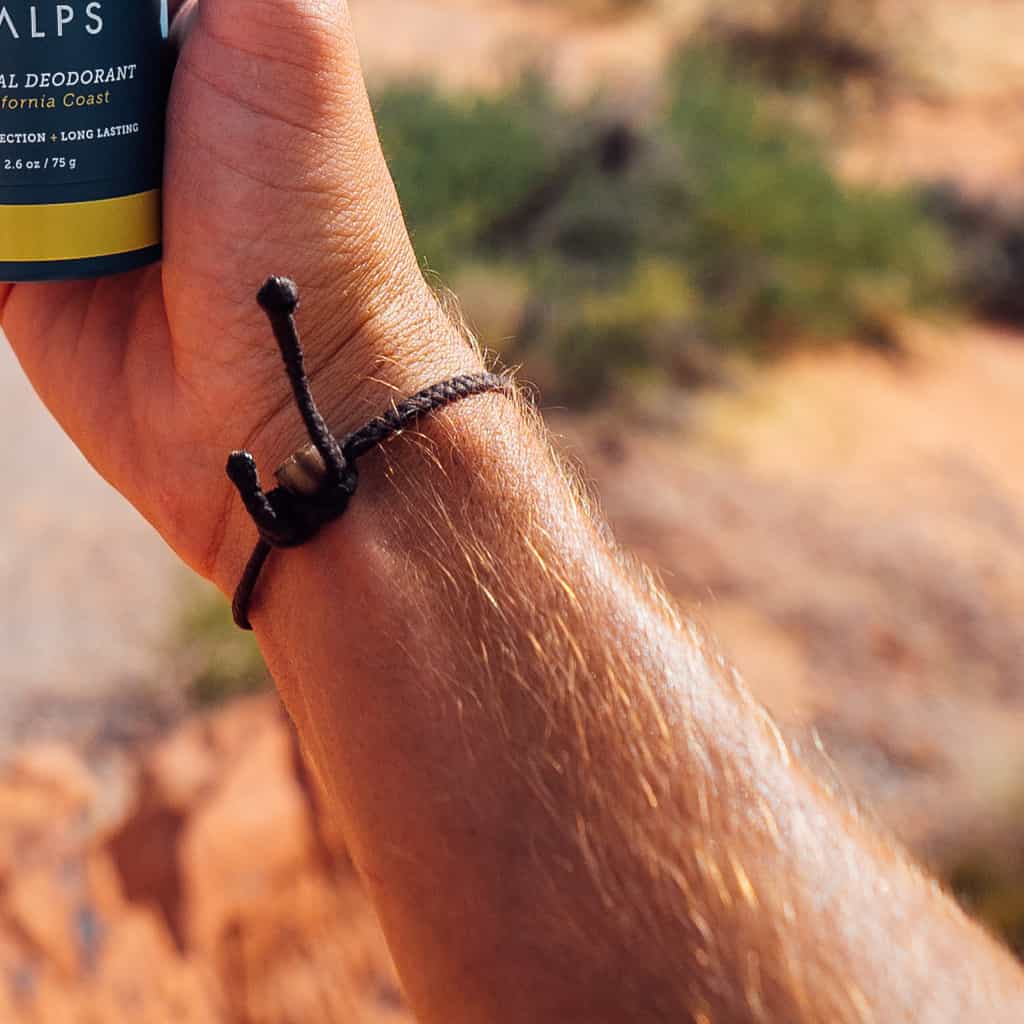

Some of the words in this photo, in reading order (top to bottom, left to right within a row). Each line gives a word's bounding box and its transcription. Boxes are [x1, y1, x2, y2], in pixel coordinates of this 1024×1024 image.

[24, 64, 137, 88] DEODORANT
[63, 90, 110, 107] Coast
[60, 129, 94, 142] LONG
[96, 122, 139, 138] LASTING
[4, 159, 23, 170] 2.6
[25, 160, 41, 169] oz
[51, 157, 66, 168] 75
[68, 158, 77, 170] g
